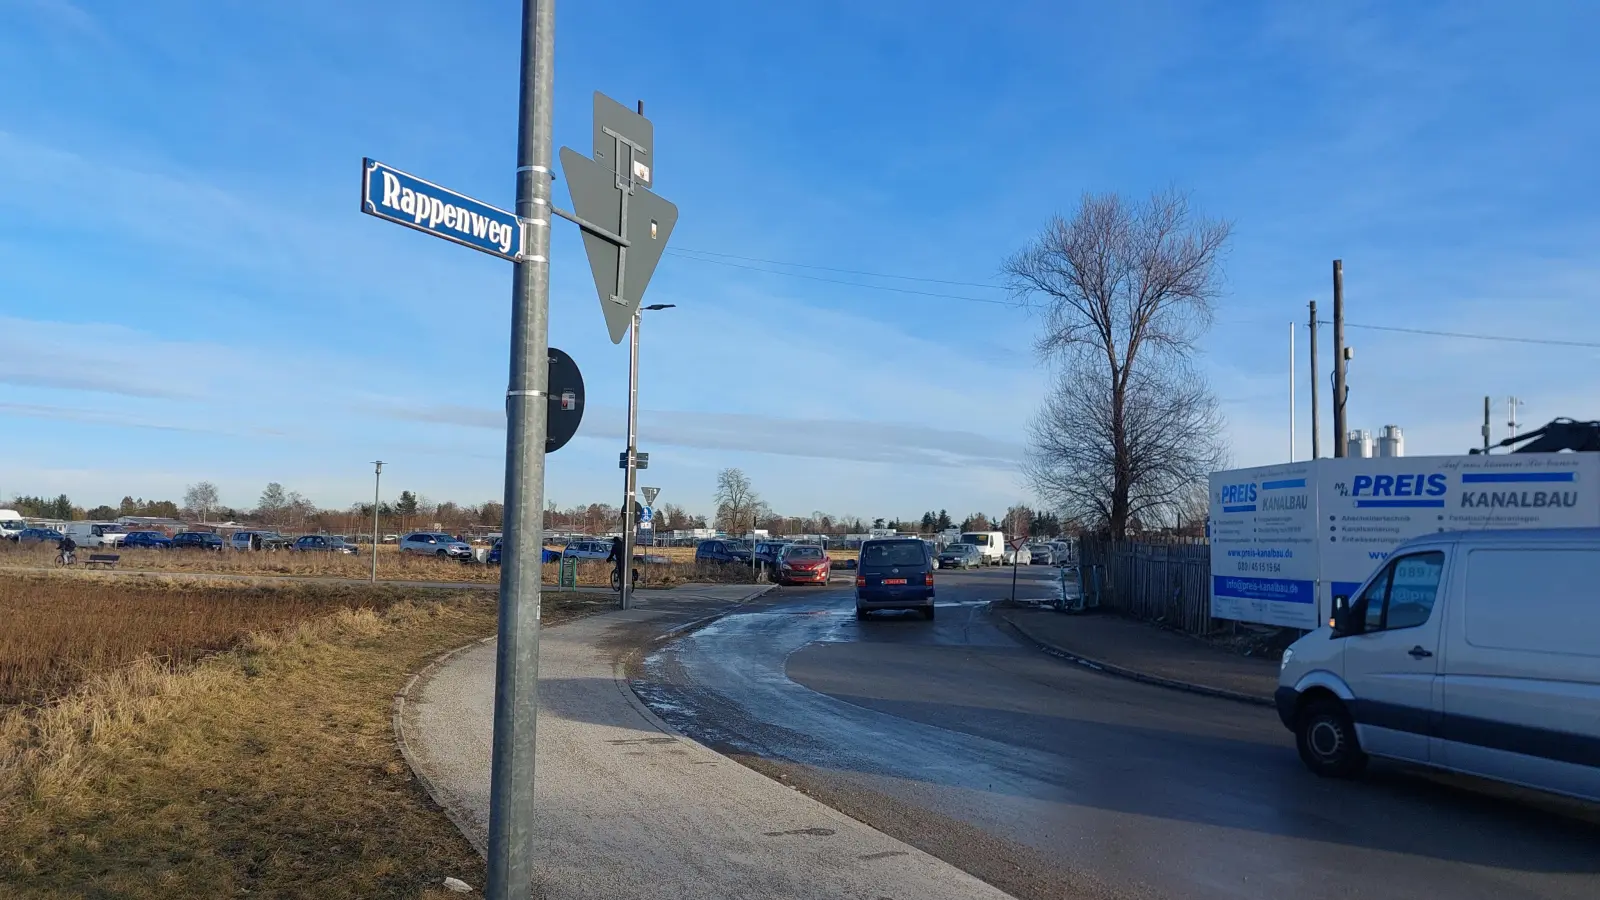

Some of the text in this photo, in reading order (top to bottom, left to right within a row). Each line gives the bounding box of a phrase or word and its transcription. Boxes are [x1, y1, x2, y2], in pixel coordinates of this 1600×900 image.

[381, 171, 513, 253] Rappenweg
[1221, 482, 1257, 504] PREIS
[1352, 473, 1447, 496] PREIS
[1262, 494, 1308, 512] KANALBAU
[1460, 491, 1578, 508] KANALBAU
[1228, 548, 1293, 559] www.preis-kanalbau.de
[1237, 561, 1248, 571] 089
[1399, 566, 1424, 577] 089
